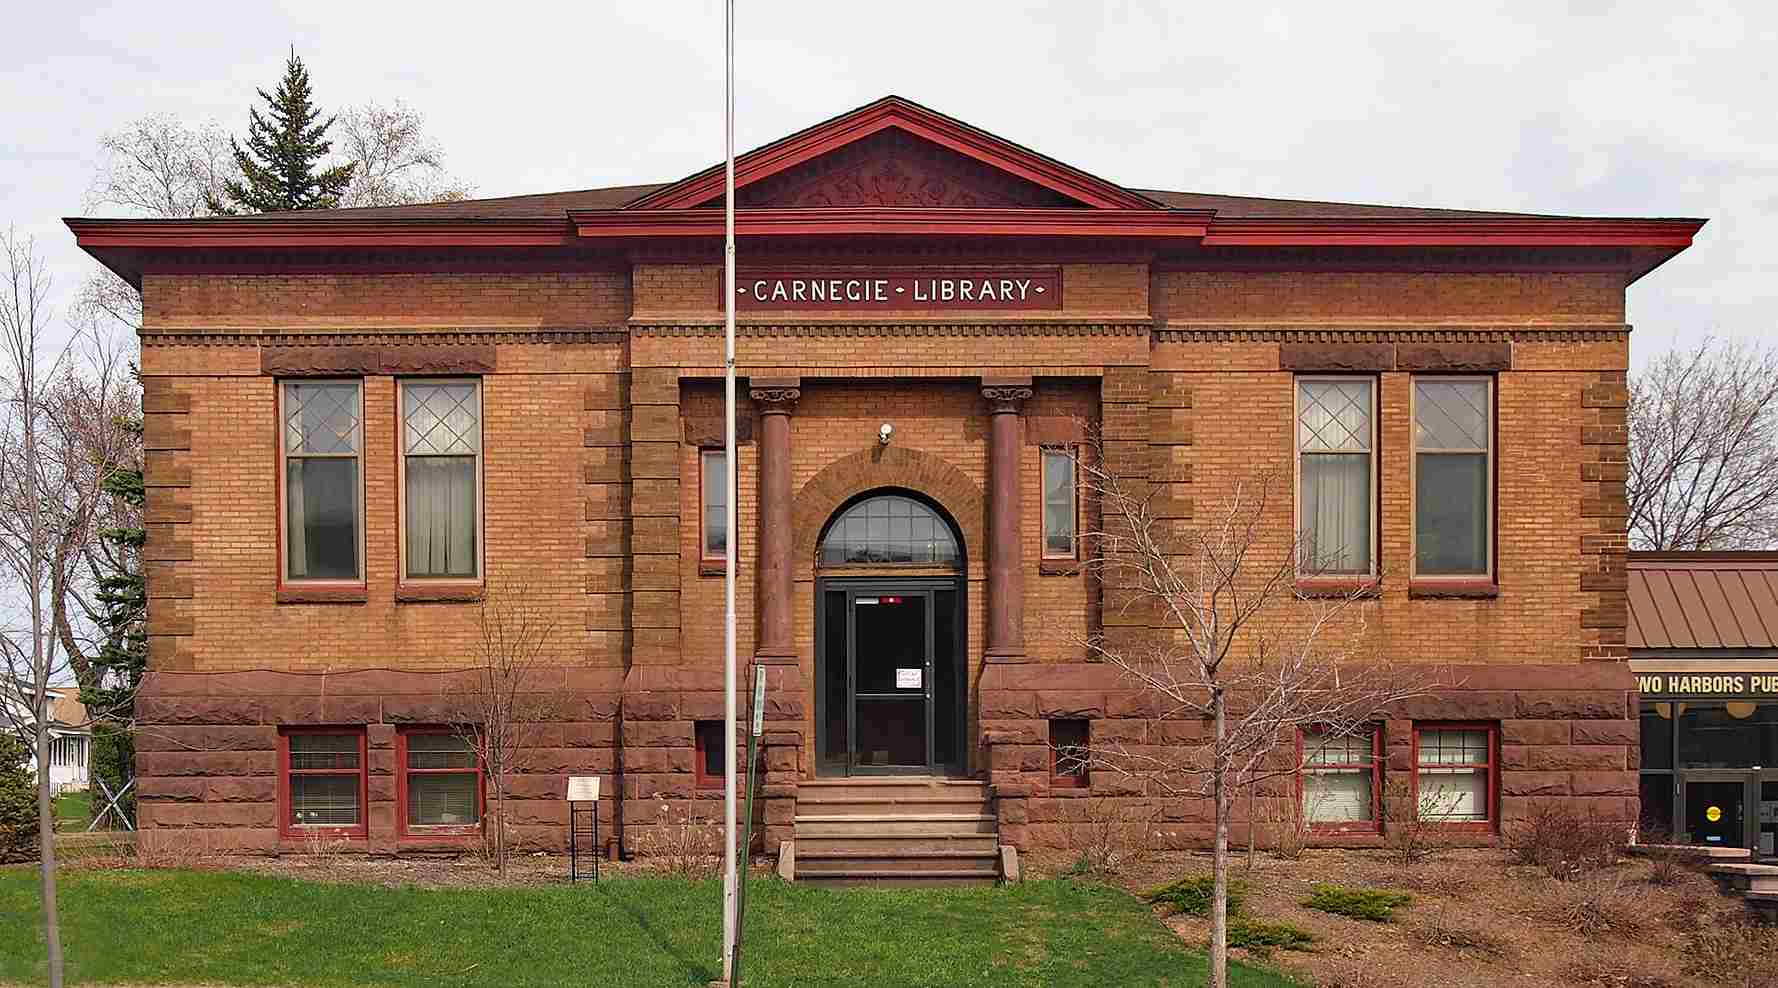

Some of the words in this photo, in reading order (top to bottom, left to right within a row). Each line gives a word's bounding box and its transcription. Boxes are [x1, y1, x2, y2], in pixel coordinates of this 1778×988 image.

[753, 280, 888, 302] CARNEGIE
[913, 280, 1032, 302] LIBRARY
[1634, 676, 1662, 692] WO
[1668, 676, 1744, 693] HARBORS
